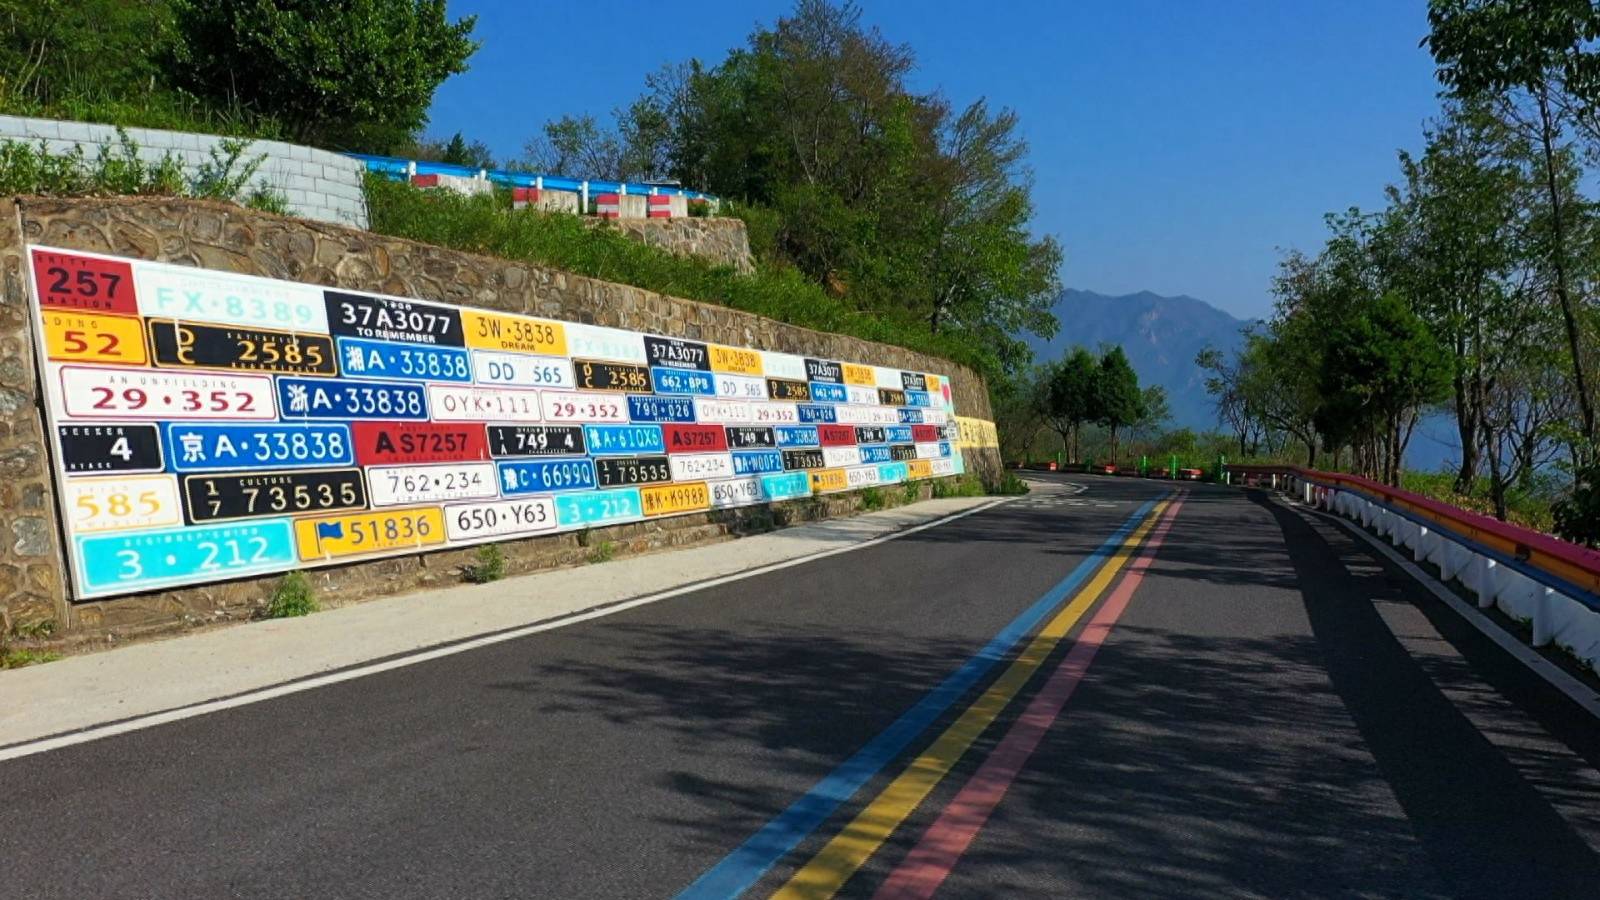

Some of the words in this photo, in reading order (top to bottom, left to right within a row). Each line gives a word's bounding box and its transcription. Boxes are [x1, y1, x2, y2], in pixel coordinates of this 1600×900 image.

[48, 267, 121, 299] 257
[340, 302, 450, 335] 37A3077
[64, 330, 122, 356] 52
[356, 326, 373, 338] TO
[374, 329, 436, 344] REMEMBER
[177, 346, 195, 364] C
[237, 340, 323, 366] 2585
[501, 340, 536, 352] DREAM
[651, 343, 703, 362] 37A3077
[489, 362, 514, 381] DD
[533, 365, 562, 384] 565
[584, 376, 593, 388] C
[608, 370, 646, 387] 2585
[91, 386, 256, 412] 29·352
[443, 394, 530, 413] OYK·111
[552, 402, 619, 418] 29·352
[516, 433, 548, 450] 749
[564, 433, 574, 449] 4
[739, 432, 756, 443] 749
[110, 436, 132, 461] 4
[602, 461, 609, 471] 1
[618, 464, 668, 483] 73535
[205, 480, 219, 496] 1
[240, 476, 292, 487] CULTURE
[387, 472, 482, 494] 762·234
[604, 474, 610, 485] 7
[242, 482, 356, 513] 73535
[714, 481, 758, 500] 650·Y63
[76, 490, 161, 521] 585
[207, 500, 221, 516] 7
[458, 503, 547, 531] 650·Y63
[350, 515, 430, 544] 51836
